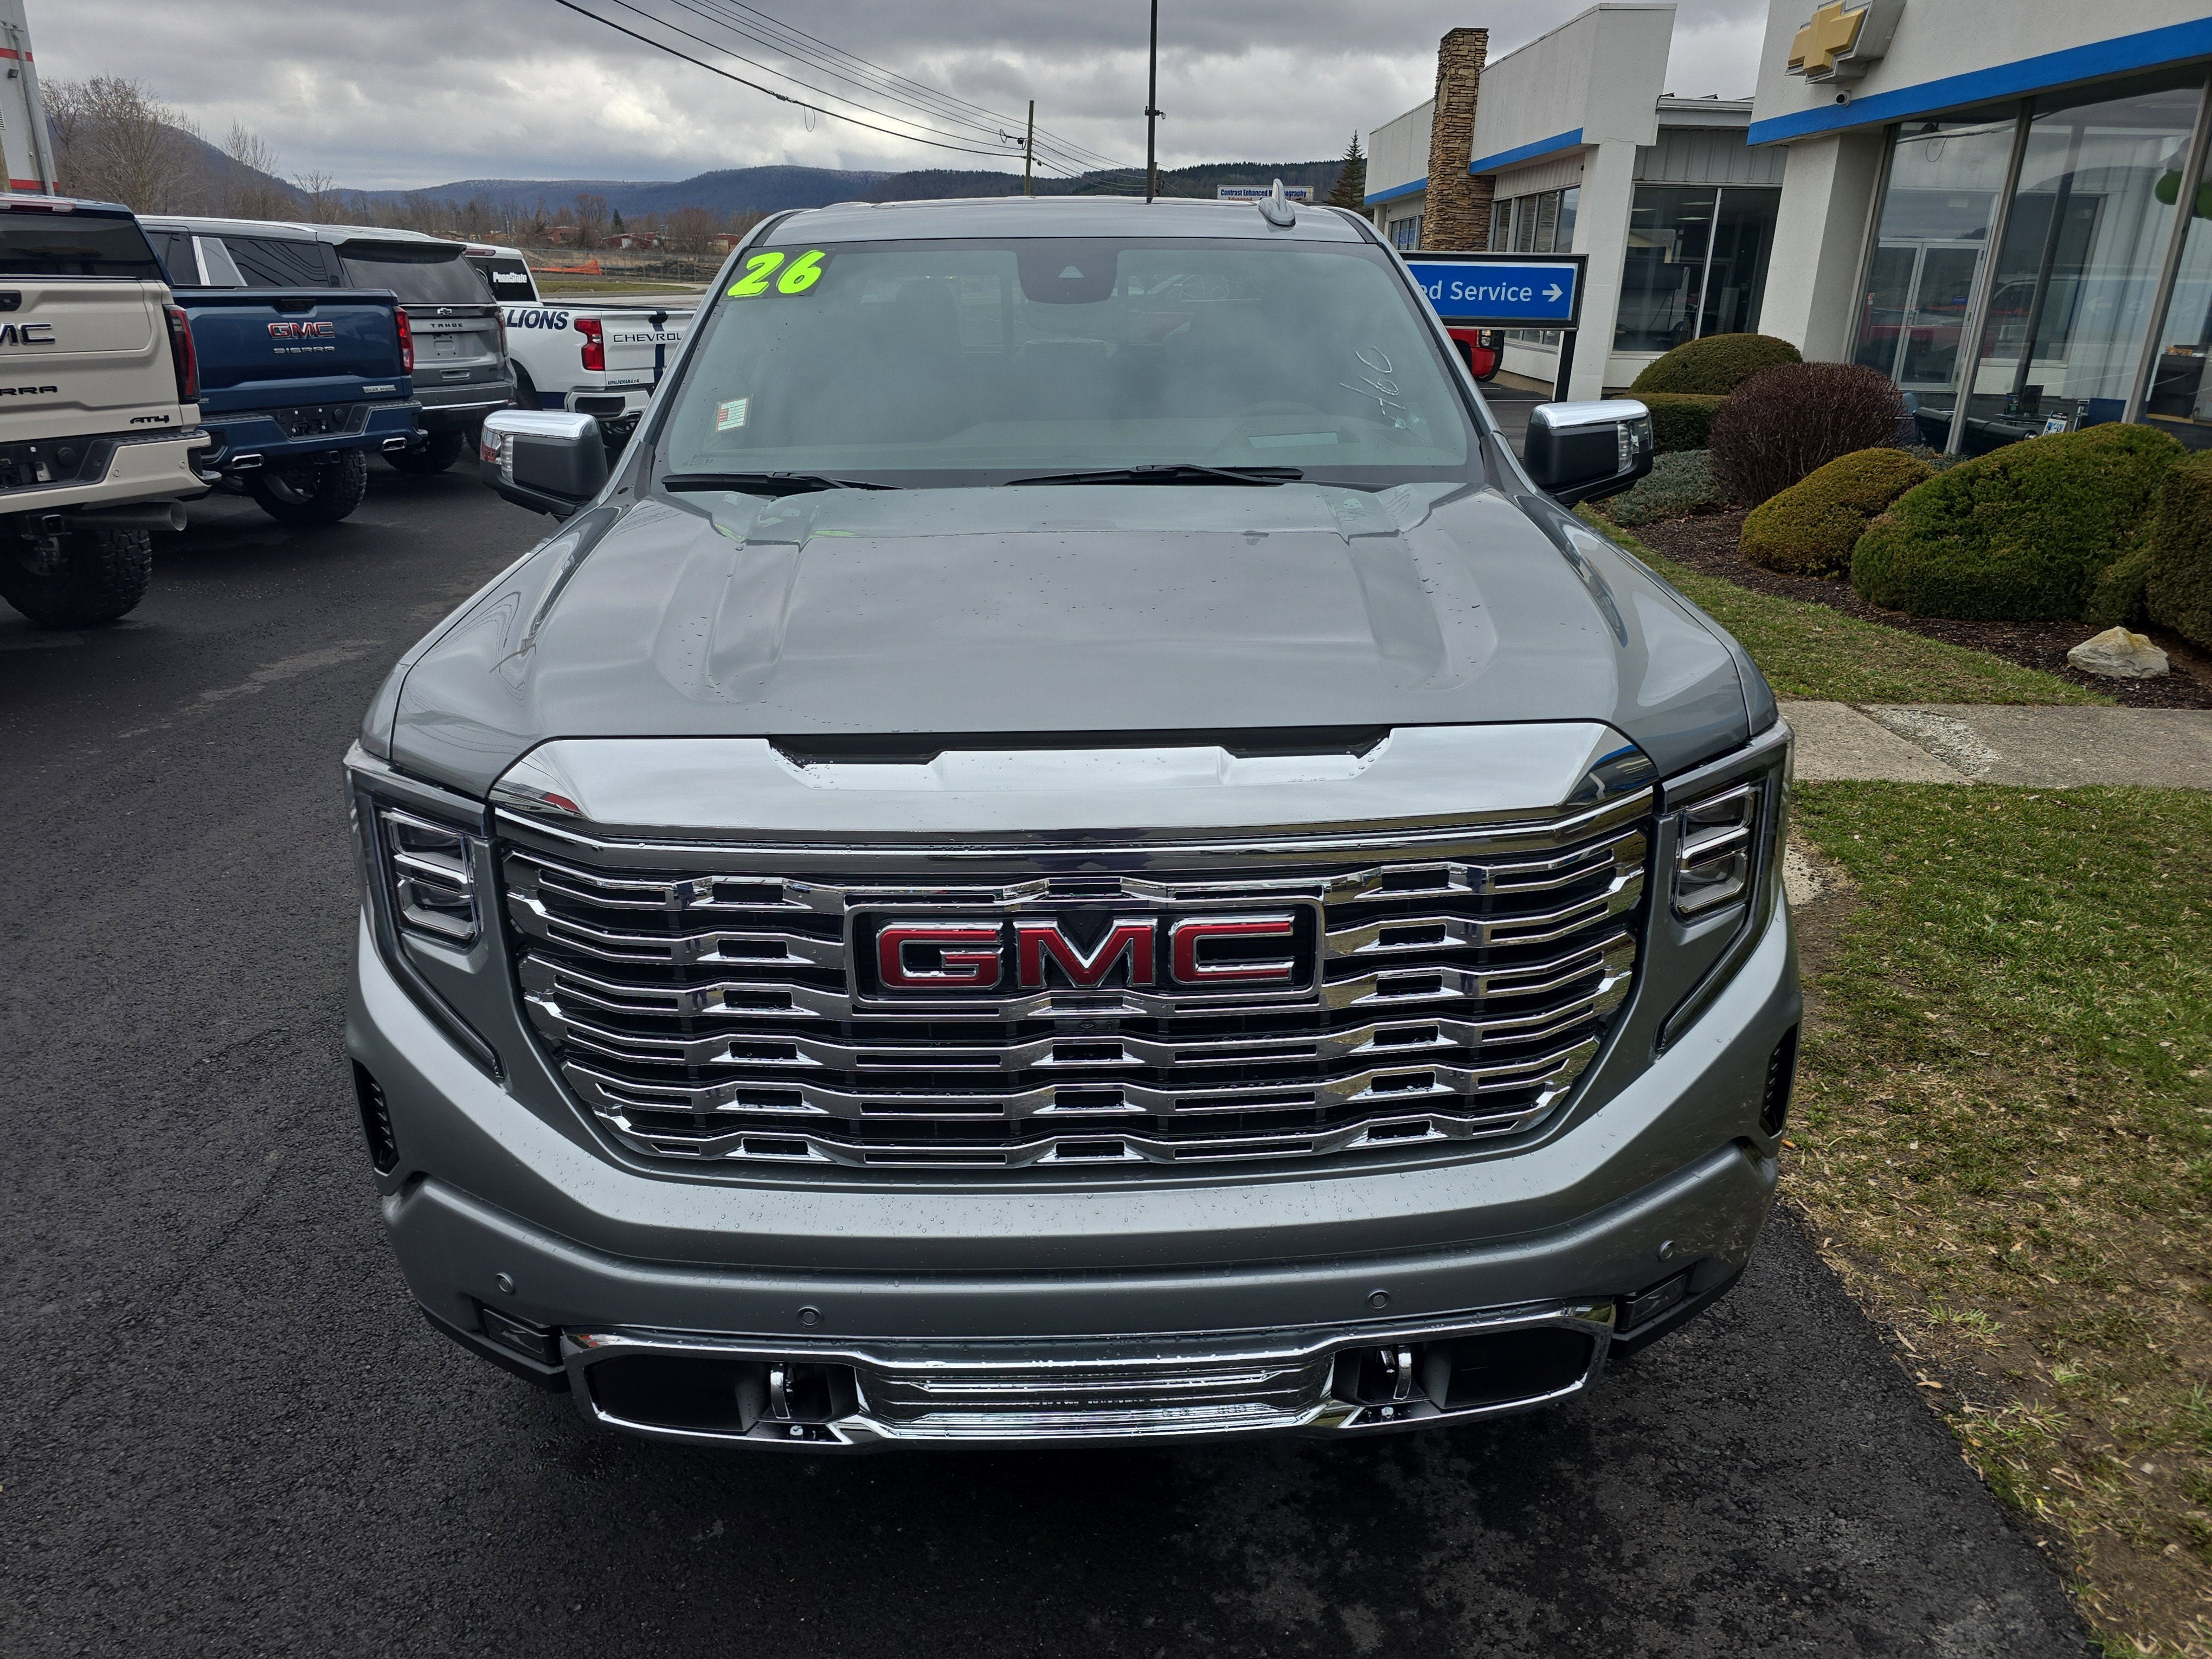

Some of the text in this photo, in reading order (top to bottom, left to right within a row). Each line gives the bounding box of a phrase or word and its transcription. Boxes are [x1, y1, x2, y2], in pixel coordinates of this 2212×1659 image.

[727, 249, 826, 298] 26
[1450, 281, 1533, 301] Service
[267, 321, 336, 339] GMC
[506, 310, 569, 330] LIONS
[130, 415, 170, 424] AT4
[876, 915, 1296, 991] GMC
